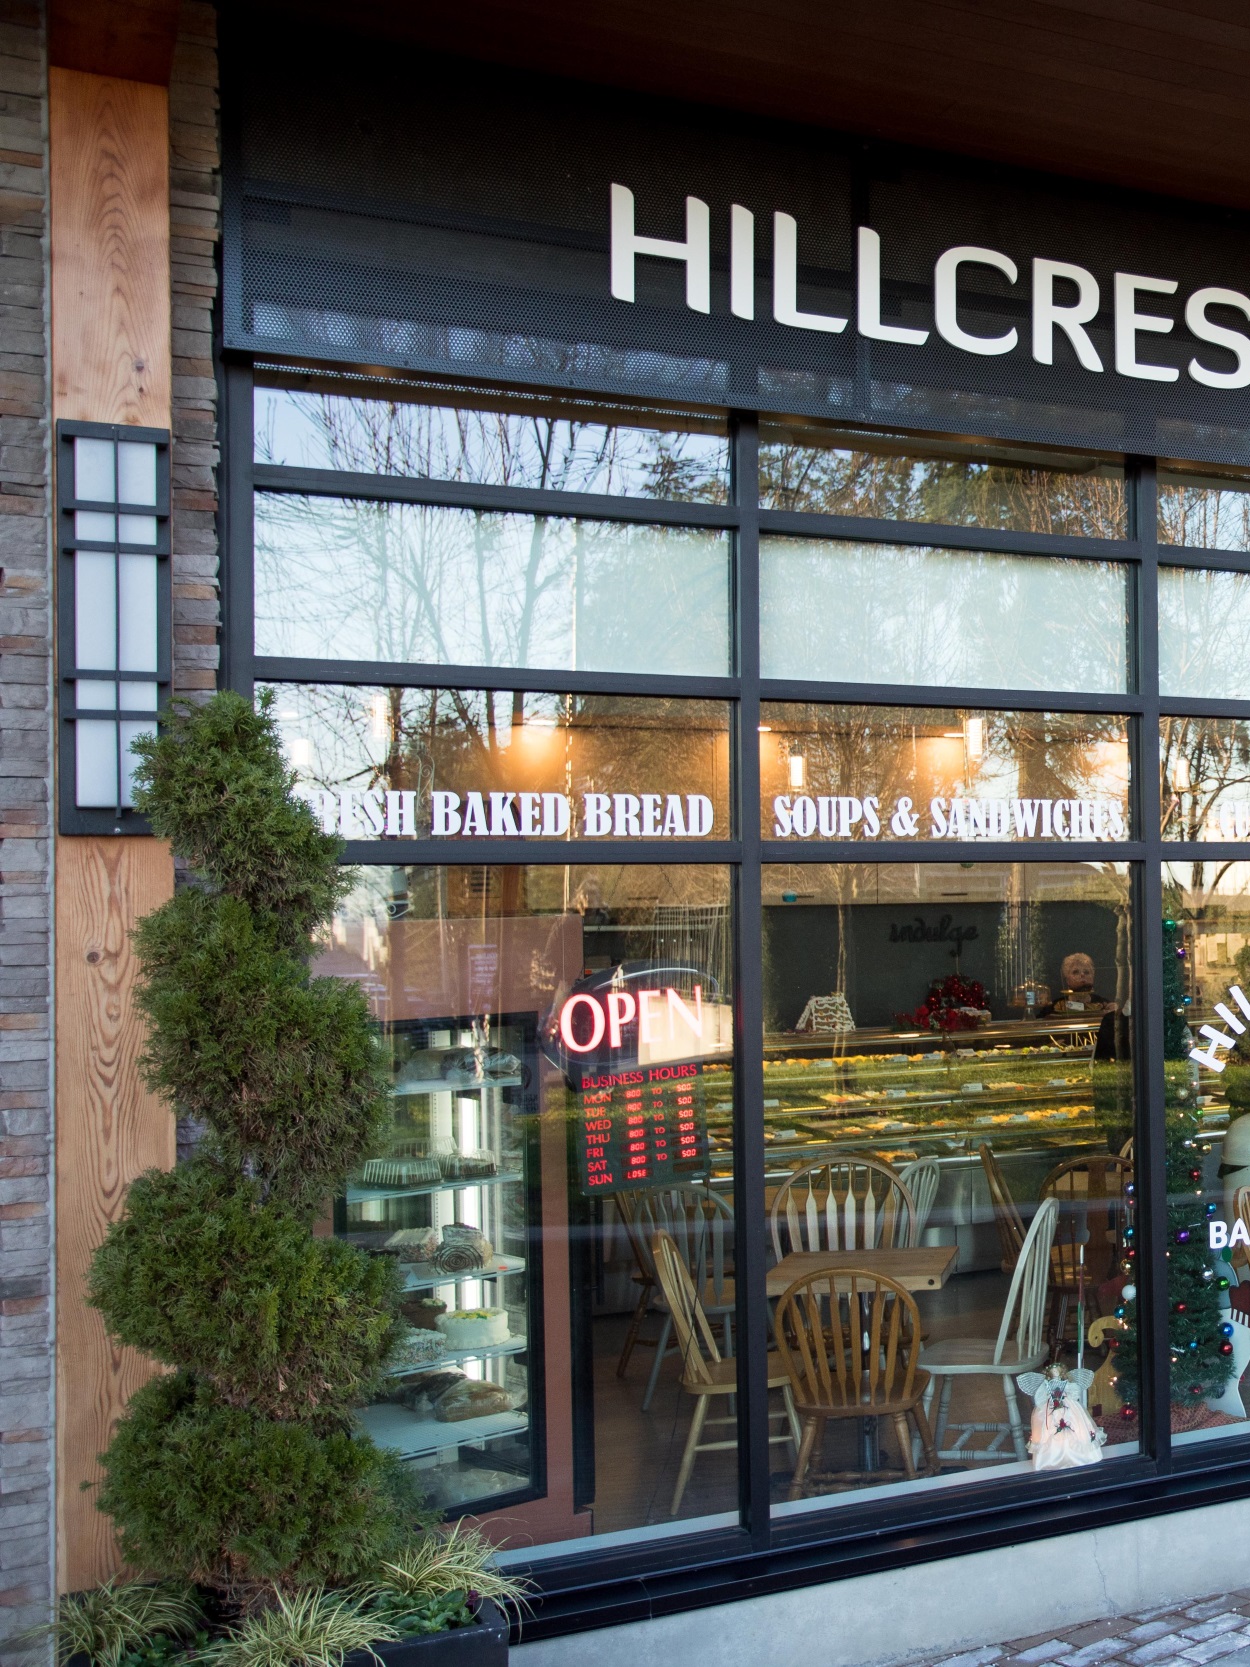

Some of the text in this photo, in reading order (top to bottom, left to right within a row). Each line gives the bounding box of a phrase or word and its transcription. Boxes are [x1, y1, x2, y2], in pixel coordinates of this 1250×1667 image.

[300, 790, 714, 837] RESH BAKED BREAD
[774, 795, 1125, 838] SOUPS & SANDWICHES
[889, 914, 980, 957] indulge
[560, 985, 702, 1053] OPEN
[581, 1064, 698, 1089] BUSINESS HOURS
[583, 1093, 612, 1104] MON
[584, 1107, 606, 1118] TUE
[585, 1120, 612, 1131] WED
[586, 1133, 611, 1145] THU
[586, 1147, 604, 1158] FRI
[588, 1160, 607, 1172] SAT
[656, 1153, 668, 1161] TO
[588, 1173, 613, 1186] SUN
